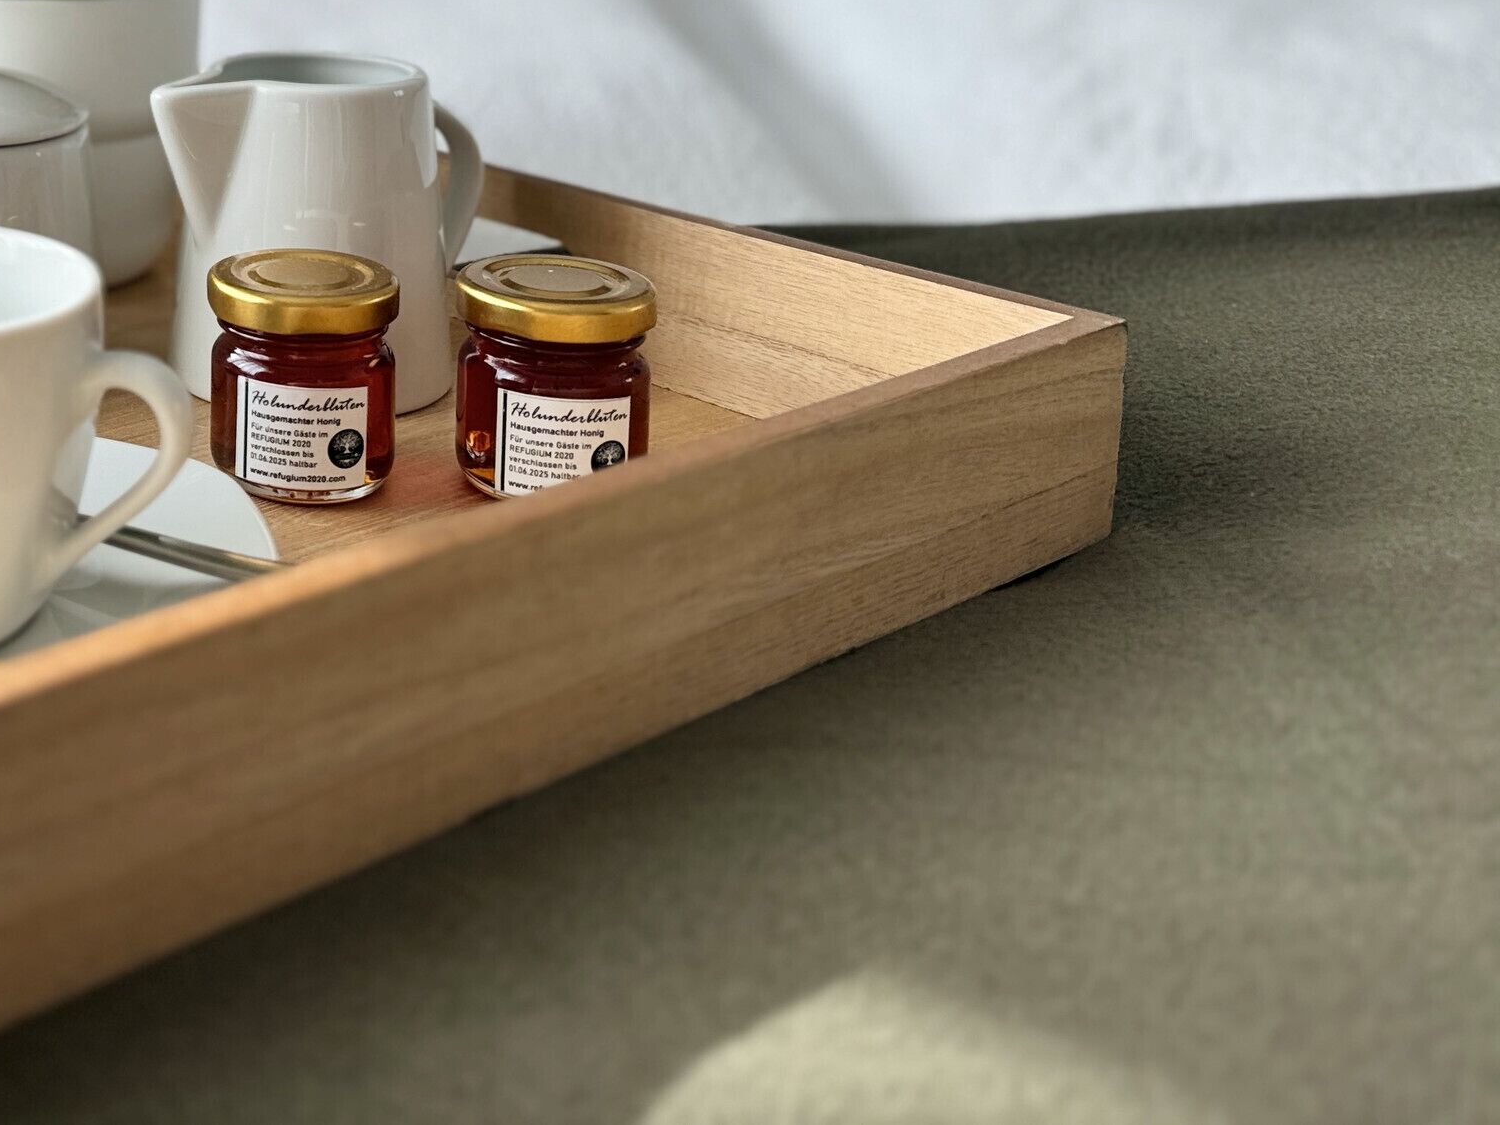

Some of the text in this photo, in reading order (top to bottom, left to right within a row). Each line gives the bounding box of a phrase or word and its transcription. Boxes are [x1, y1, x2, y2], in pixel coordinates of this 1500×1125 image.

[251, 410, 341, 426] Hausgemachter Honig
[251, 422, 263, 431] Für
[265, 427, 291, 436] unsere
[294, 430, 316, 438] Gäste
[510, 421, 604, 437] Hausgemachter Honig
[251, 432, 311, 448] REFUGIUM 2020
[510, 434, 523, 443] Für
[525, 439, 553, 448] unsere
[556, 441, 579, 449] Gäste
[251, 443, 300, 457] verschlossen
[509, 445, 552, 458] REFUGIUM
[251, 452, 318, 468] 01.06.2025 haltbar
[509, 456, 577, 470] verschlossen bis
[250, 468, 345, 483] www.refugium2020.com
[509, 464, 548, 478] 01.06.2025
